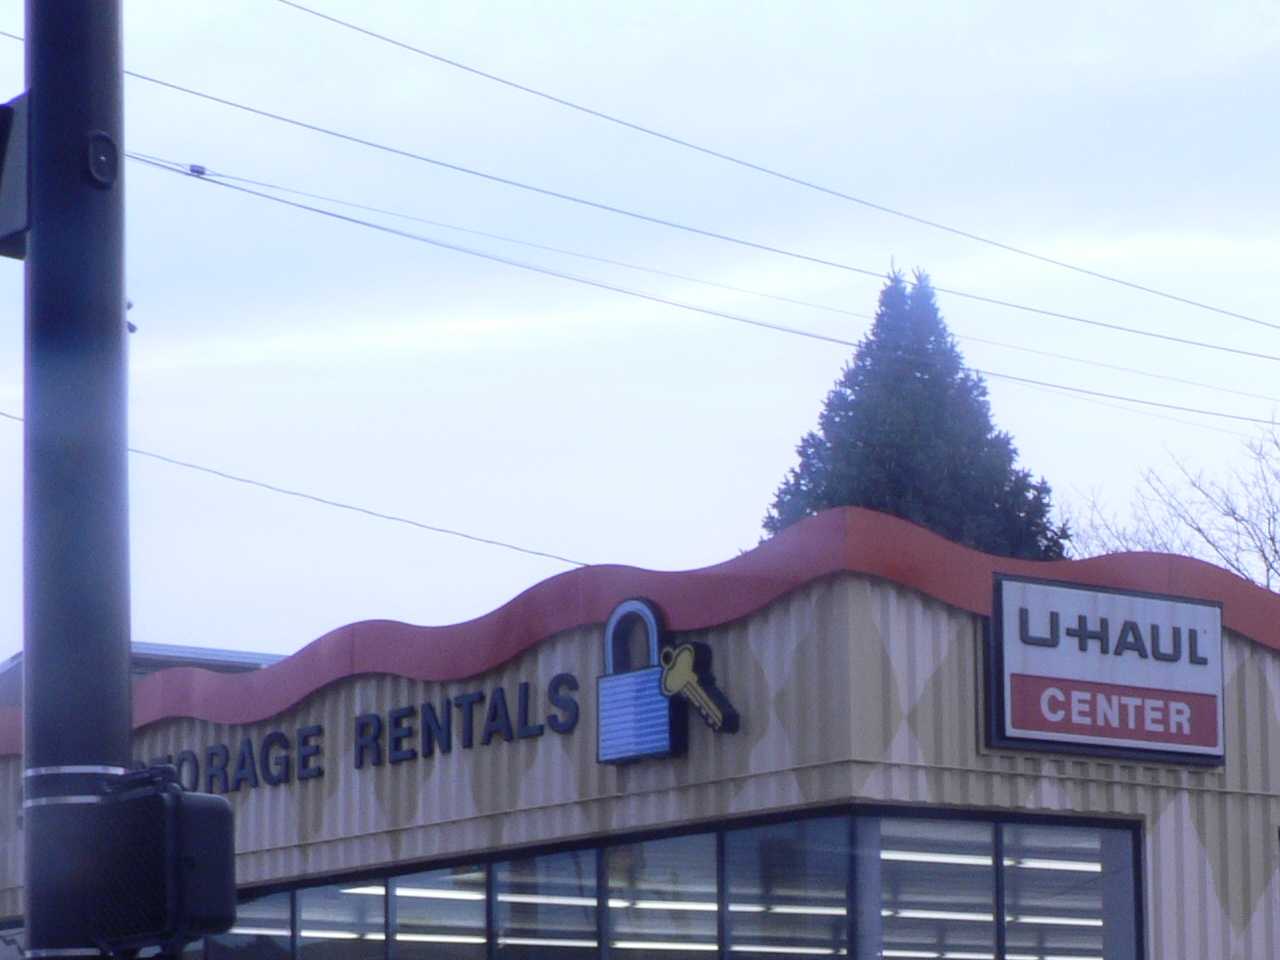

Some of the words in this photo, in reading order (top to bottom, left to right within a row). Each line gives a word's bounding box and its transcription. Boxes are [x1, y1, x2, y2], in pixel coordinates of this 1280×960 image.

[1019, 607, 1208, 666] U-HAUL
[135, 725, 324, 794] ORAGE
[354, 673, 580, 770] RENTALS
[1040, 687, 1192, 735] CENTER
